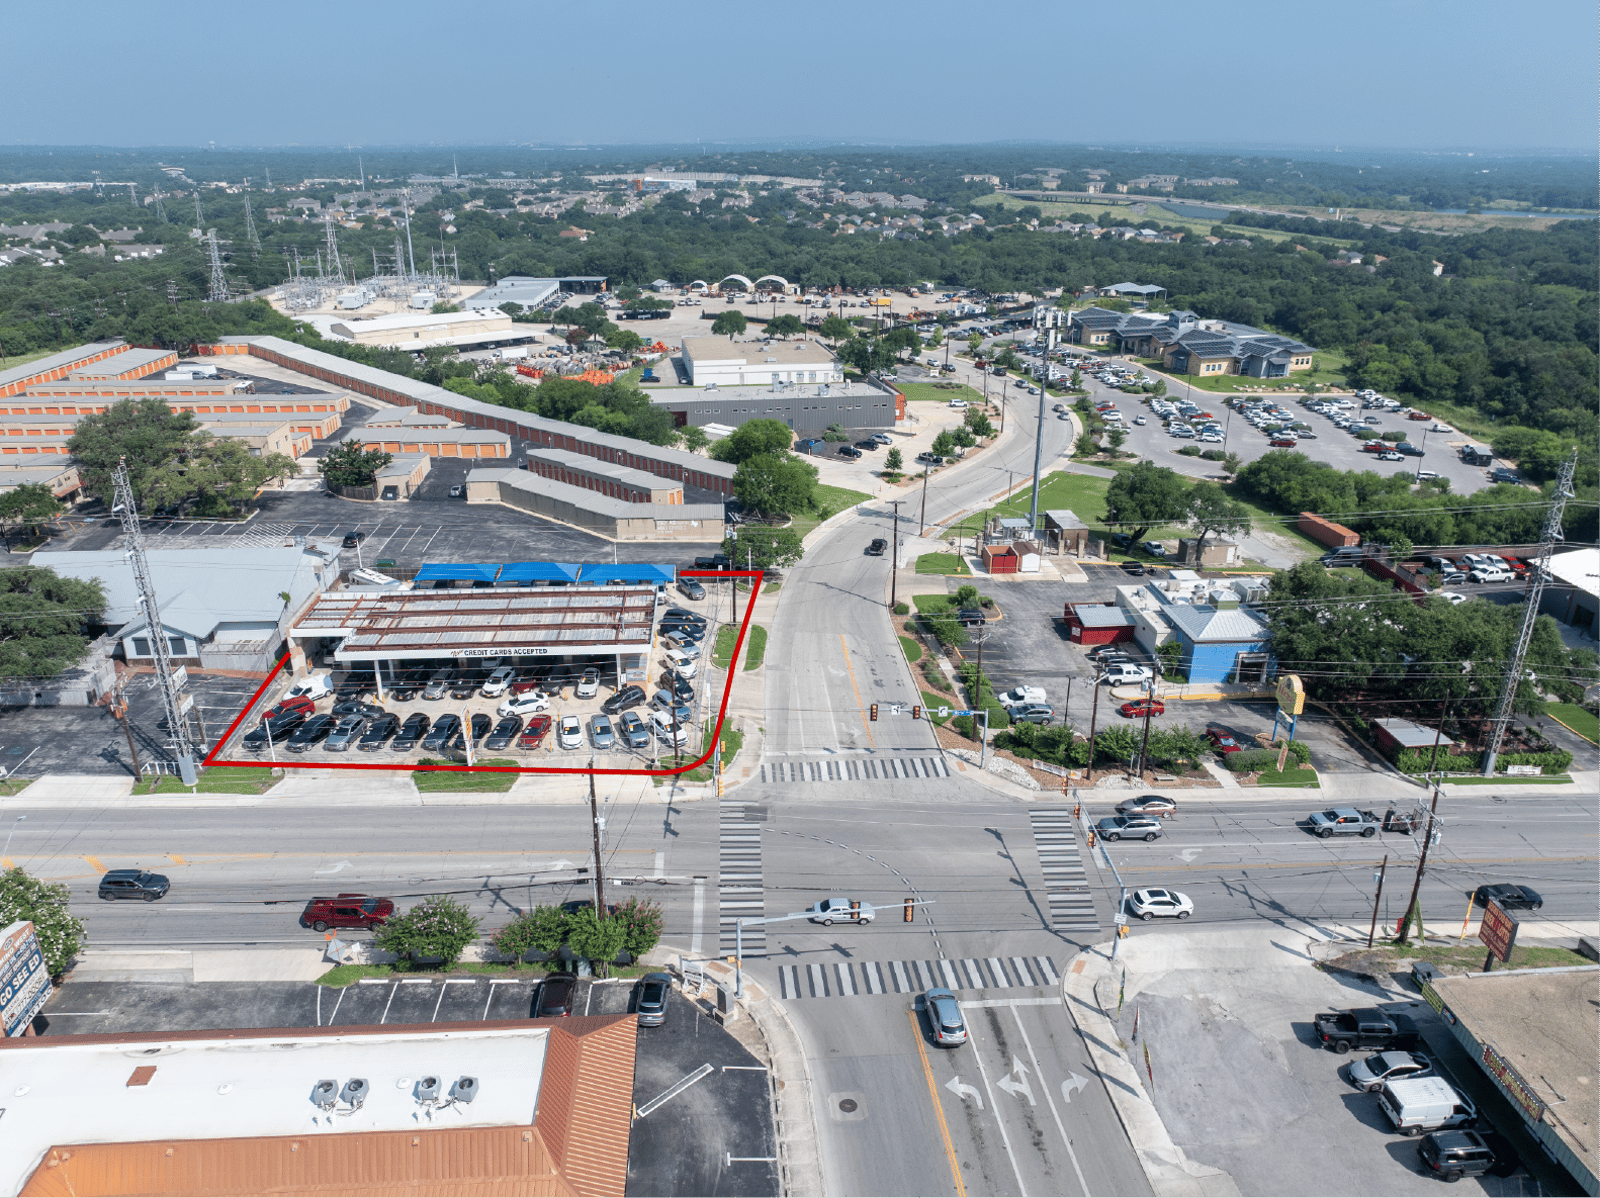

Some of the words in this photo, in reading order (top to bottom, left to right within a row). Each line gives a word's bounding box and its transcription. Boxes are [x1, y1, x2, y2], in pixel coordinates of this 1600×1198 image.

[14, 928, 30, 948] WEST
[0, 986, 12, 1006] GO
[13, 966, 30, 990] SEE
[28, 953, 40, 972] ED
[22, 986, 53, 1026] TATTOO
